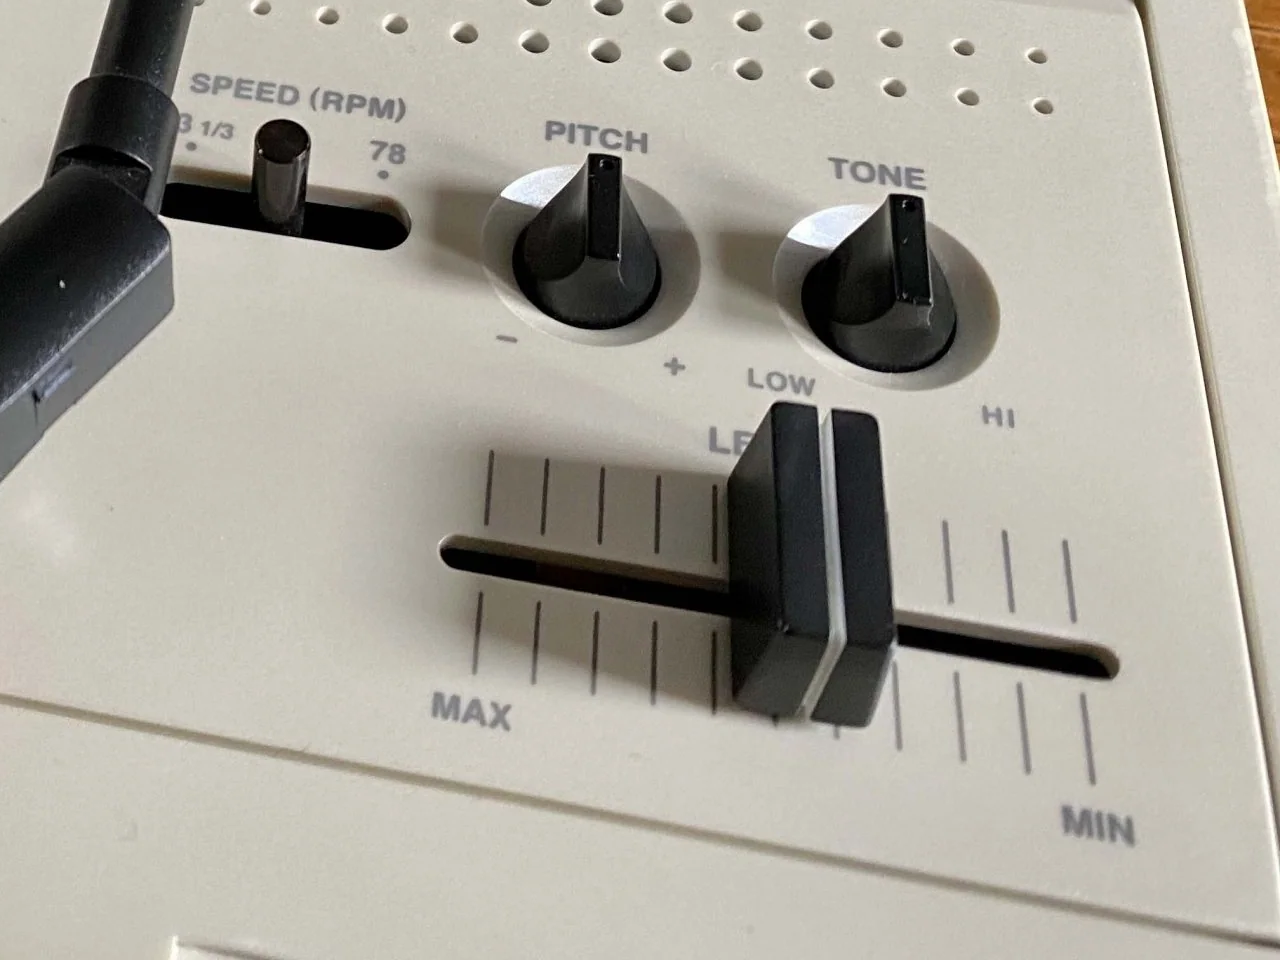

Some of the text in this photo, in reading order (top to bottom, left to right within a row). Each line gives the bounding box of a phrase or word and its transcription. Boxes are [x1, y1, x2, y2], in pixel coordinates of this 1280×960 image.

[190, 72, 407, 124] SPEED (RPM)
[178, 112, 235, 140] 3 1/3
[545, 119, 649, 155] PITCH
[369, 140, 407, 165] 78
[827, 156, 928, 191] TONE
[747, 367, 816, 397] LOW
[981, 404, 1016, 429] HI
[430, 690, 513, 733] MAX
[1060, 805, 1136, 848] MIN
